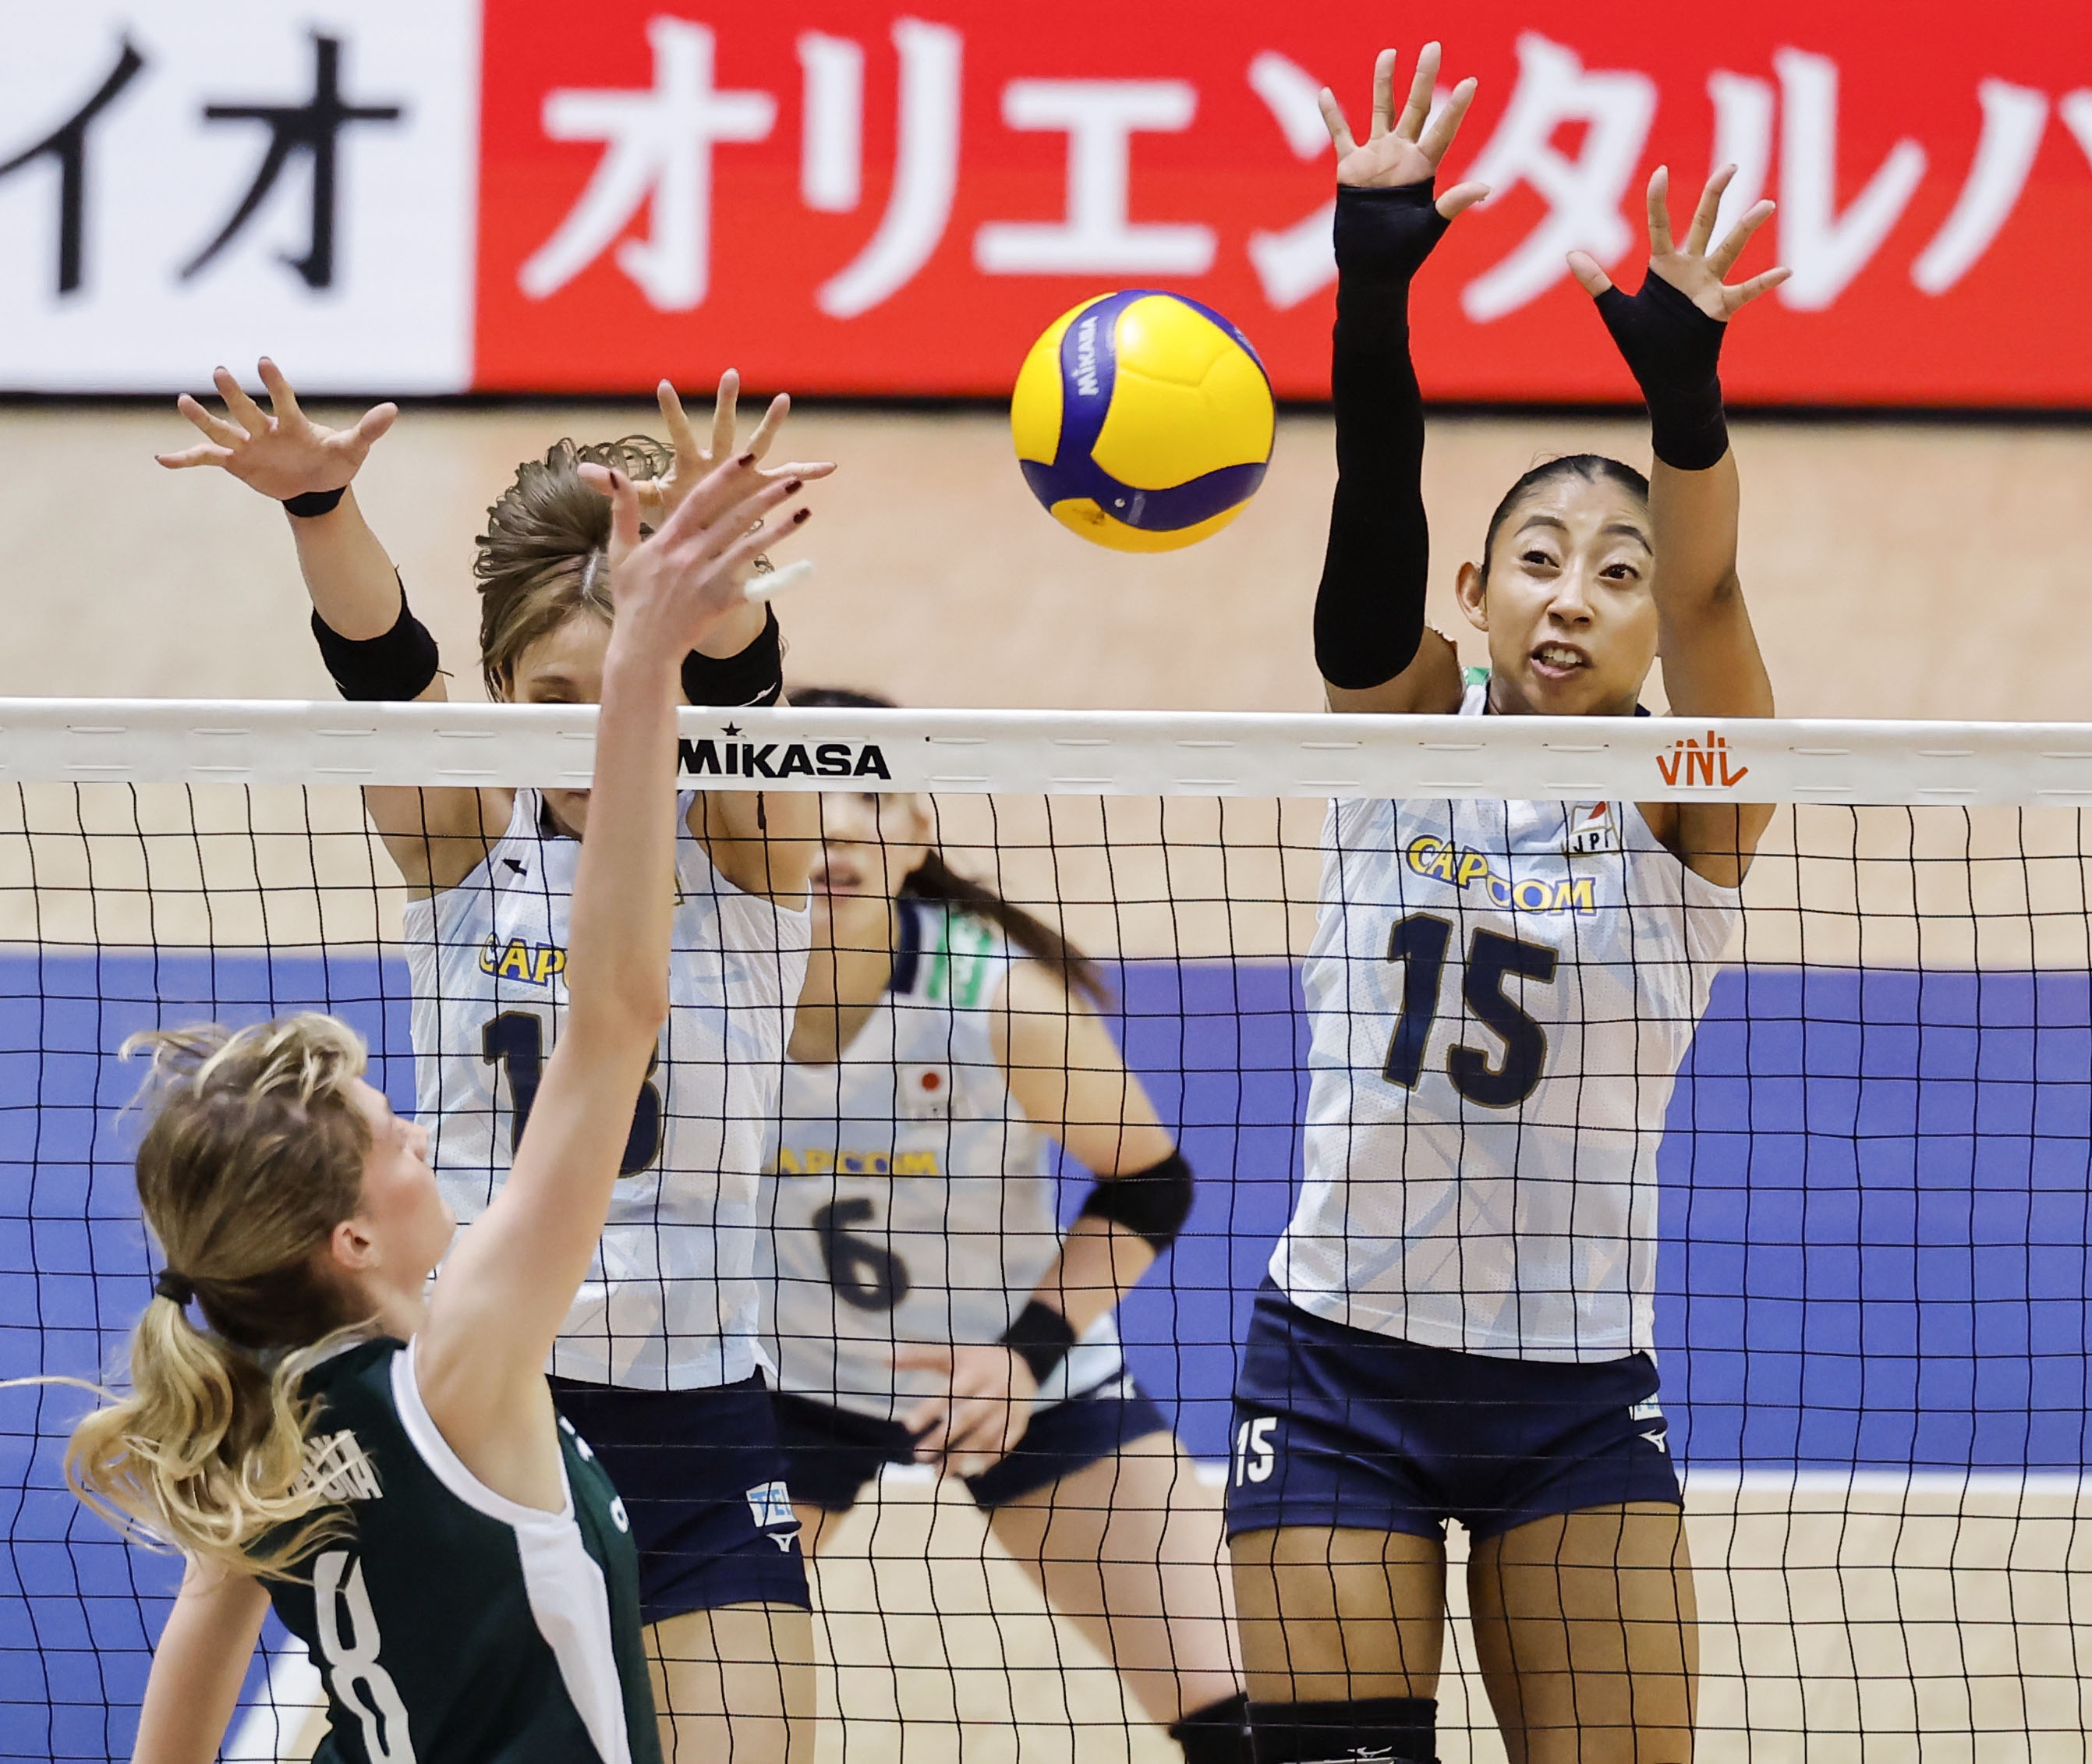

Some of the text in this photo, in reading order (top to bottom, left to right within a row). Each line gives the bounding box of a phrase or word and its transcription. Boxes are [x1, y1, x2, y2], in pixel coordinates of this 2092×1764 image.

[678, 738, 892, 781] MIKASA
[1655, 730, 1748, 787] VNL
[1406, 834, 1598, 916] CAPCOM
[1382, 912, 1559, 1109] 15
[762, 1146, 940, 1176] APCOM
[811, 1196, 911, 1312] 6
[1236, 1416, 1278, 1488] 15
[313, 1550, 418, 1764] 8
